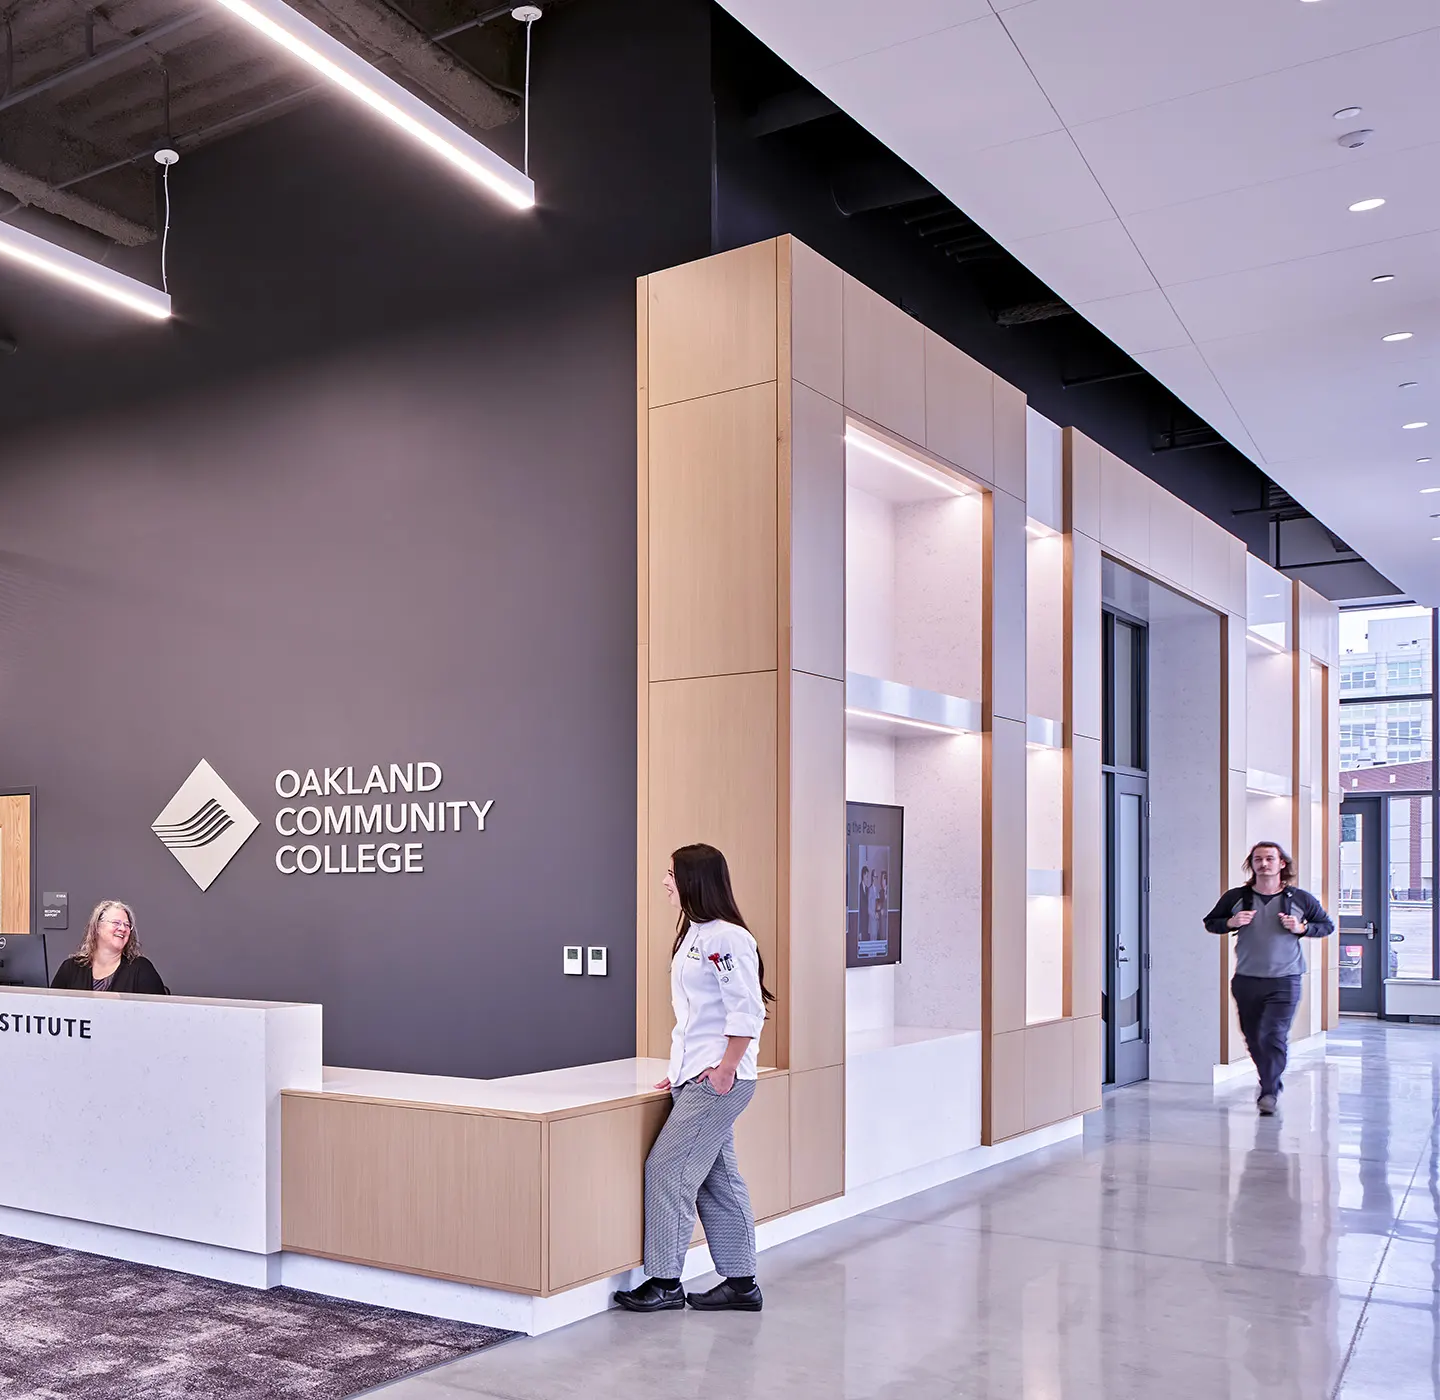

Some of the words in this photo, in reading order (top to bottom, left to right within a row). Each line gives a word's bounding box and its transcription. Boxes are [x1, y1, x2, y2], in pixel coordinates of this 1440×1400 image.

[275, 762, 443, 798] OAKLAND
[275, 800, 495, 836] COMMUNITY
[852, 820, 861, 834] the
[862, 821, 876, 835] Past
[275, 843, 425, 874] COLLEGE
